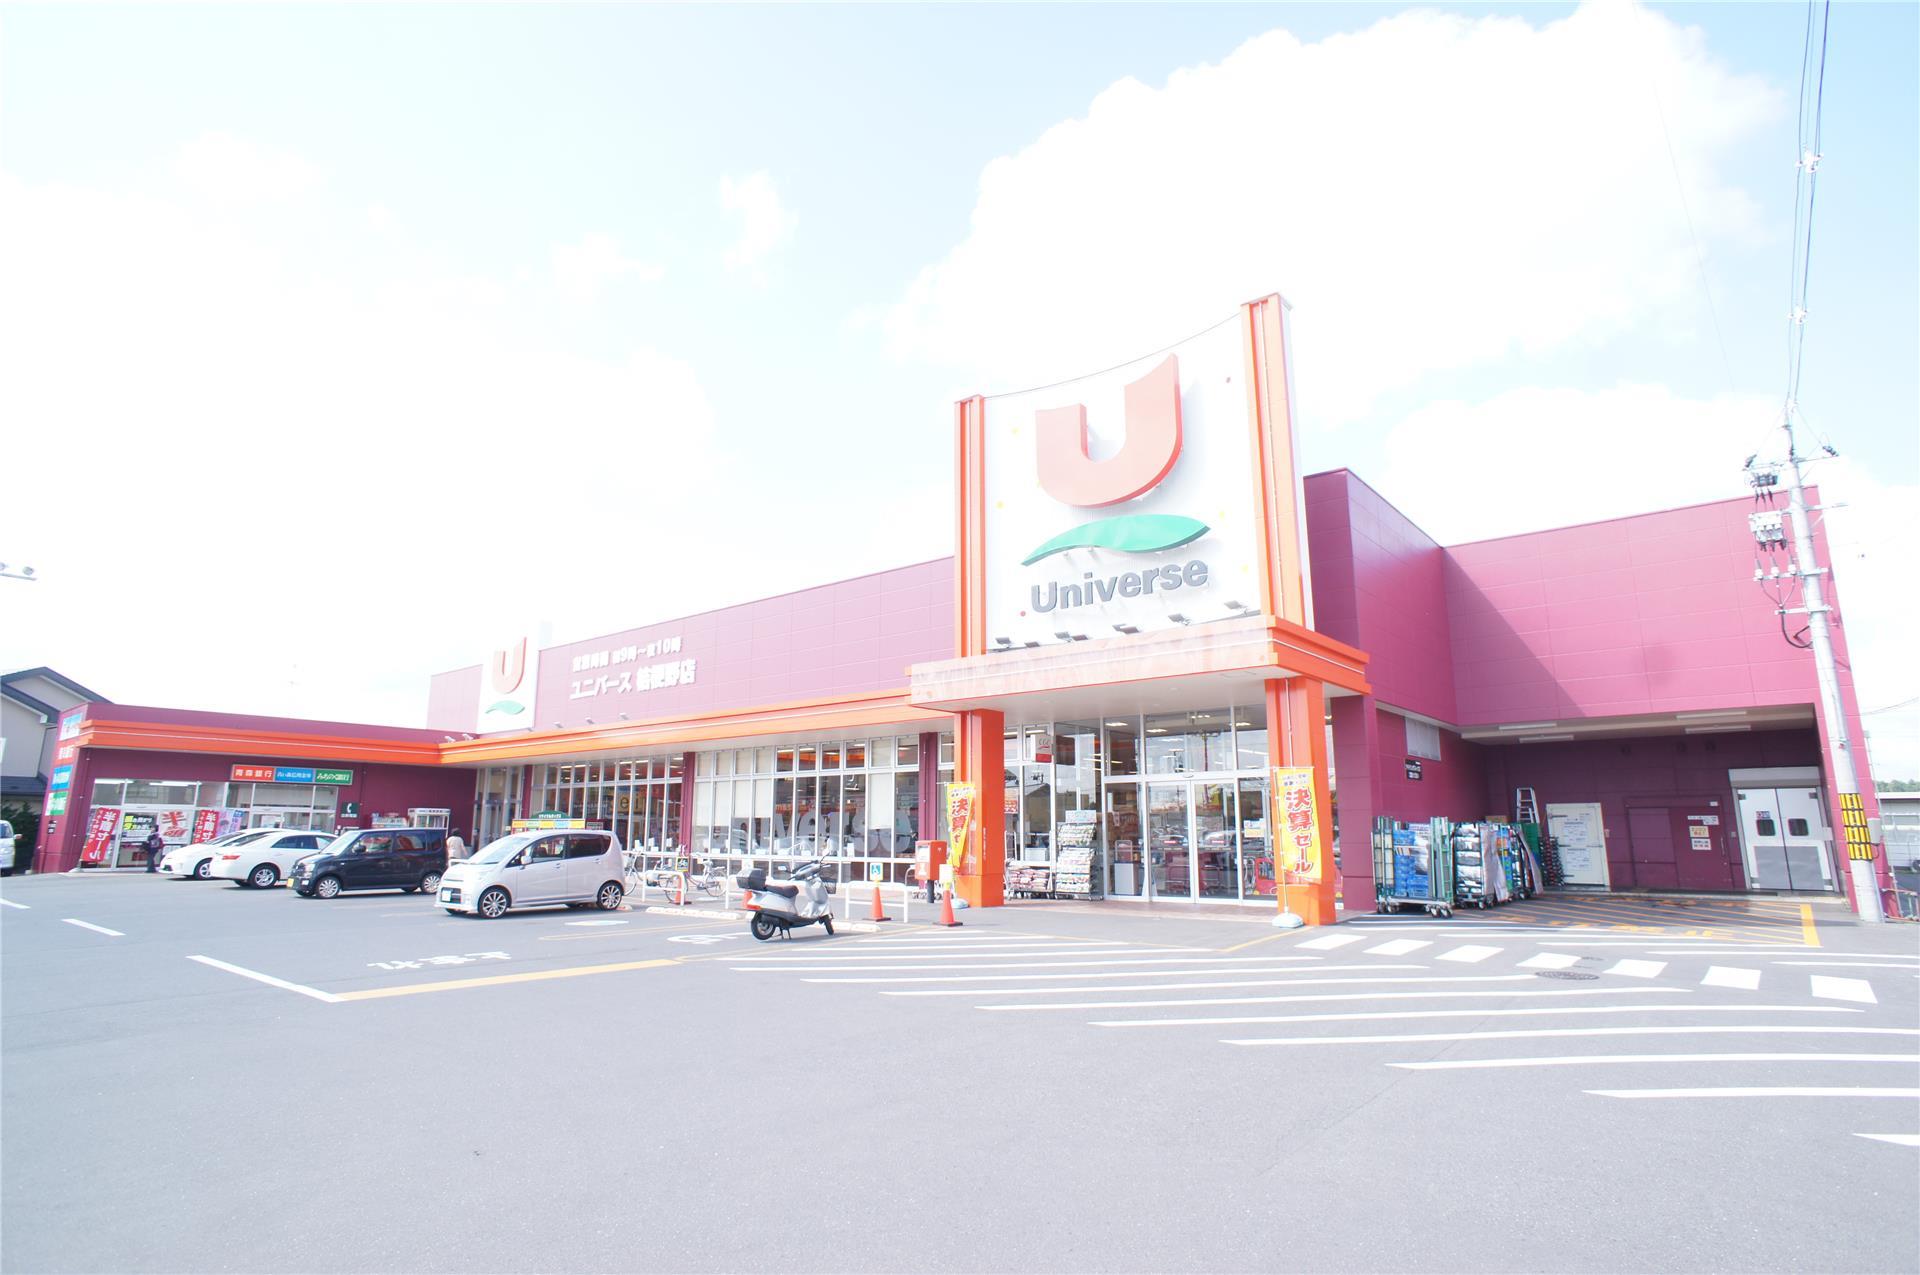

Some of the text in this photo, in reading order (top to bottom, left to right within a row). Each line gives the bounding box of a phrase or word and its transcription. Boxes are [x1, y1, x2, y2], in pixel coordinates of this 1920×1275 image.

[1035, 352, 1183, 509] U
[1030, 559, 1209, 614] Universe
[492, 636, 527, 695] U
[569, 671, 633, 699] ユニバース
[1285, 786, 1313, 873] 決算セール
